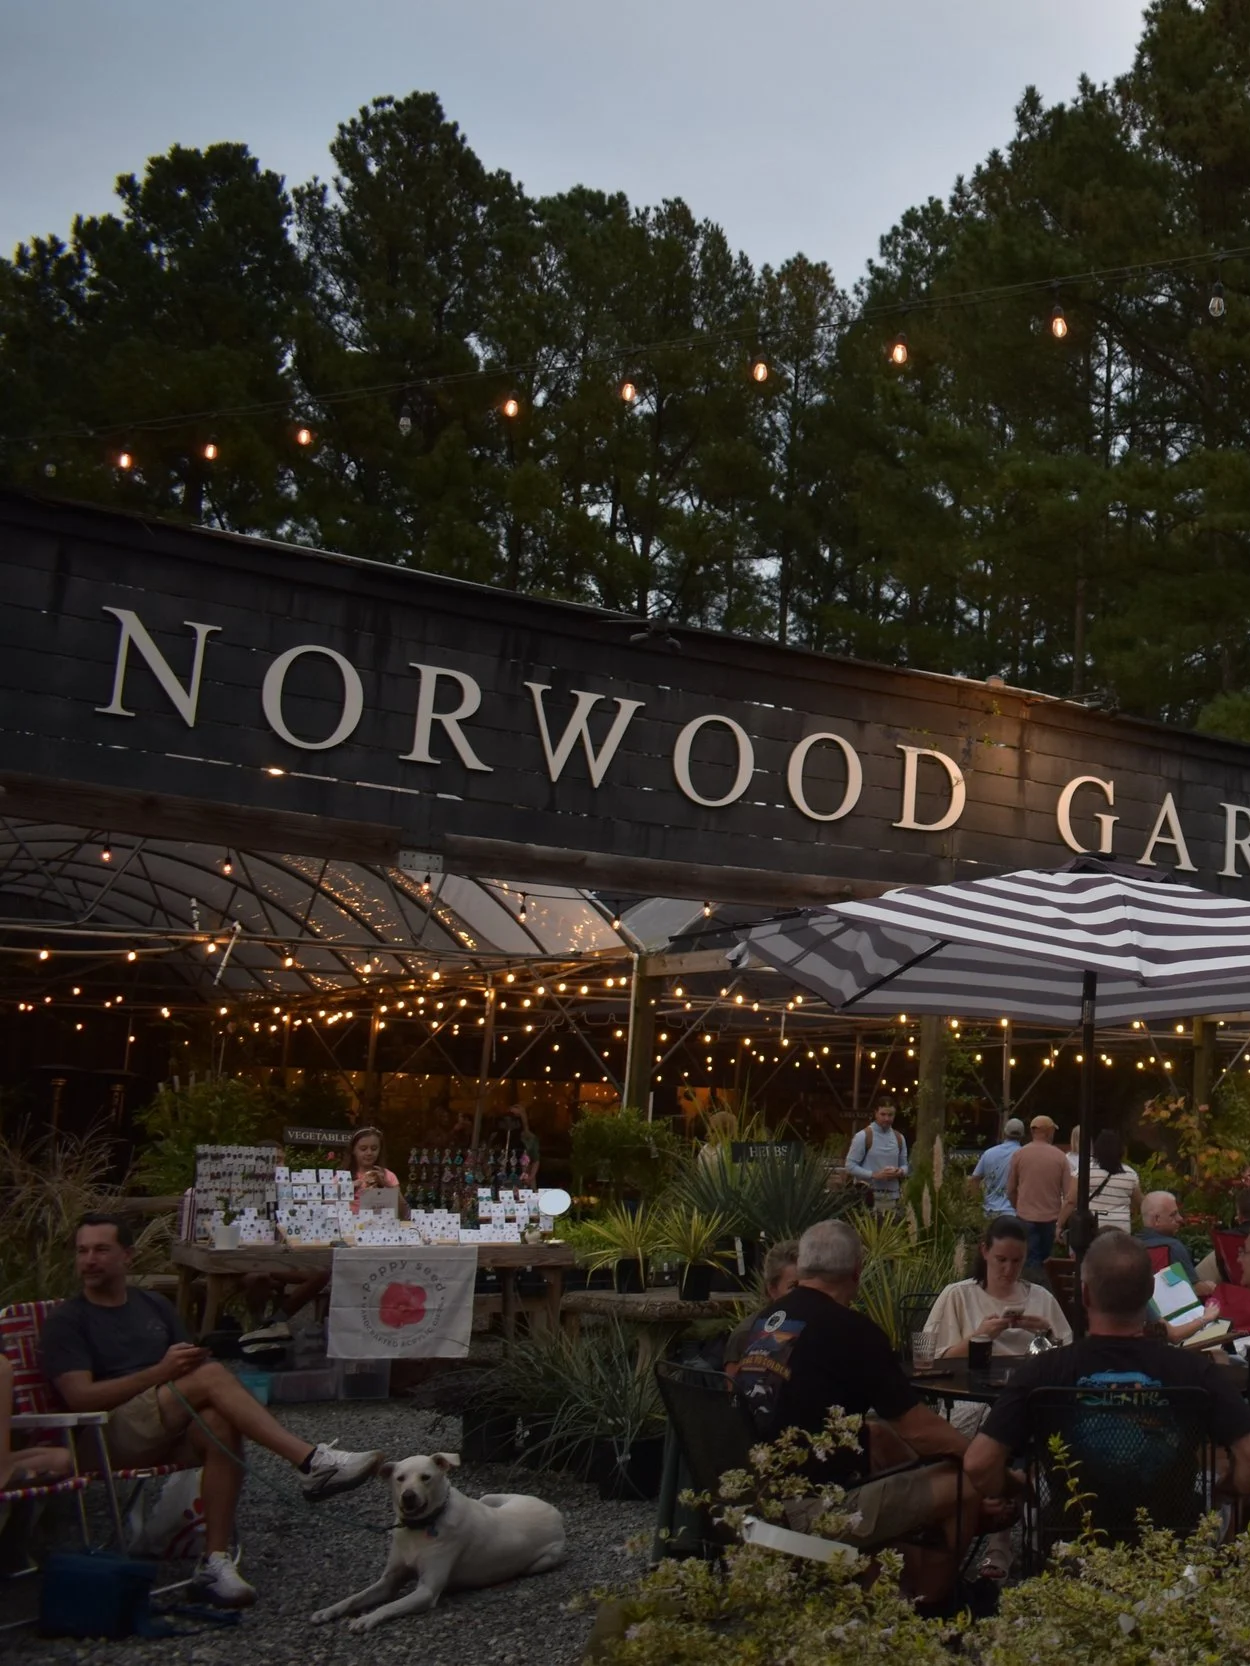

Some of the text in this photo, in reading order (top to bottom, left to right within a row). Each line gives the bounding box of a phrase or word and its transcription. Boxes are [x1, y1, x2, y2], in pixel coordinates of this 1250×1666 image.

[95, 606, 966, 832] NORWOOD
[288, 1130, 354, 1142] VEGETABLES
[362, 1260, 446, 1293] poppy seed
